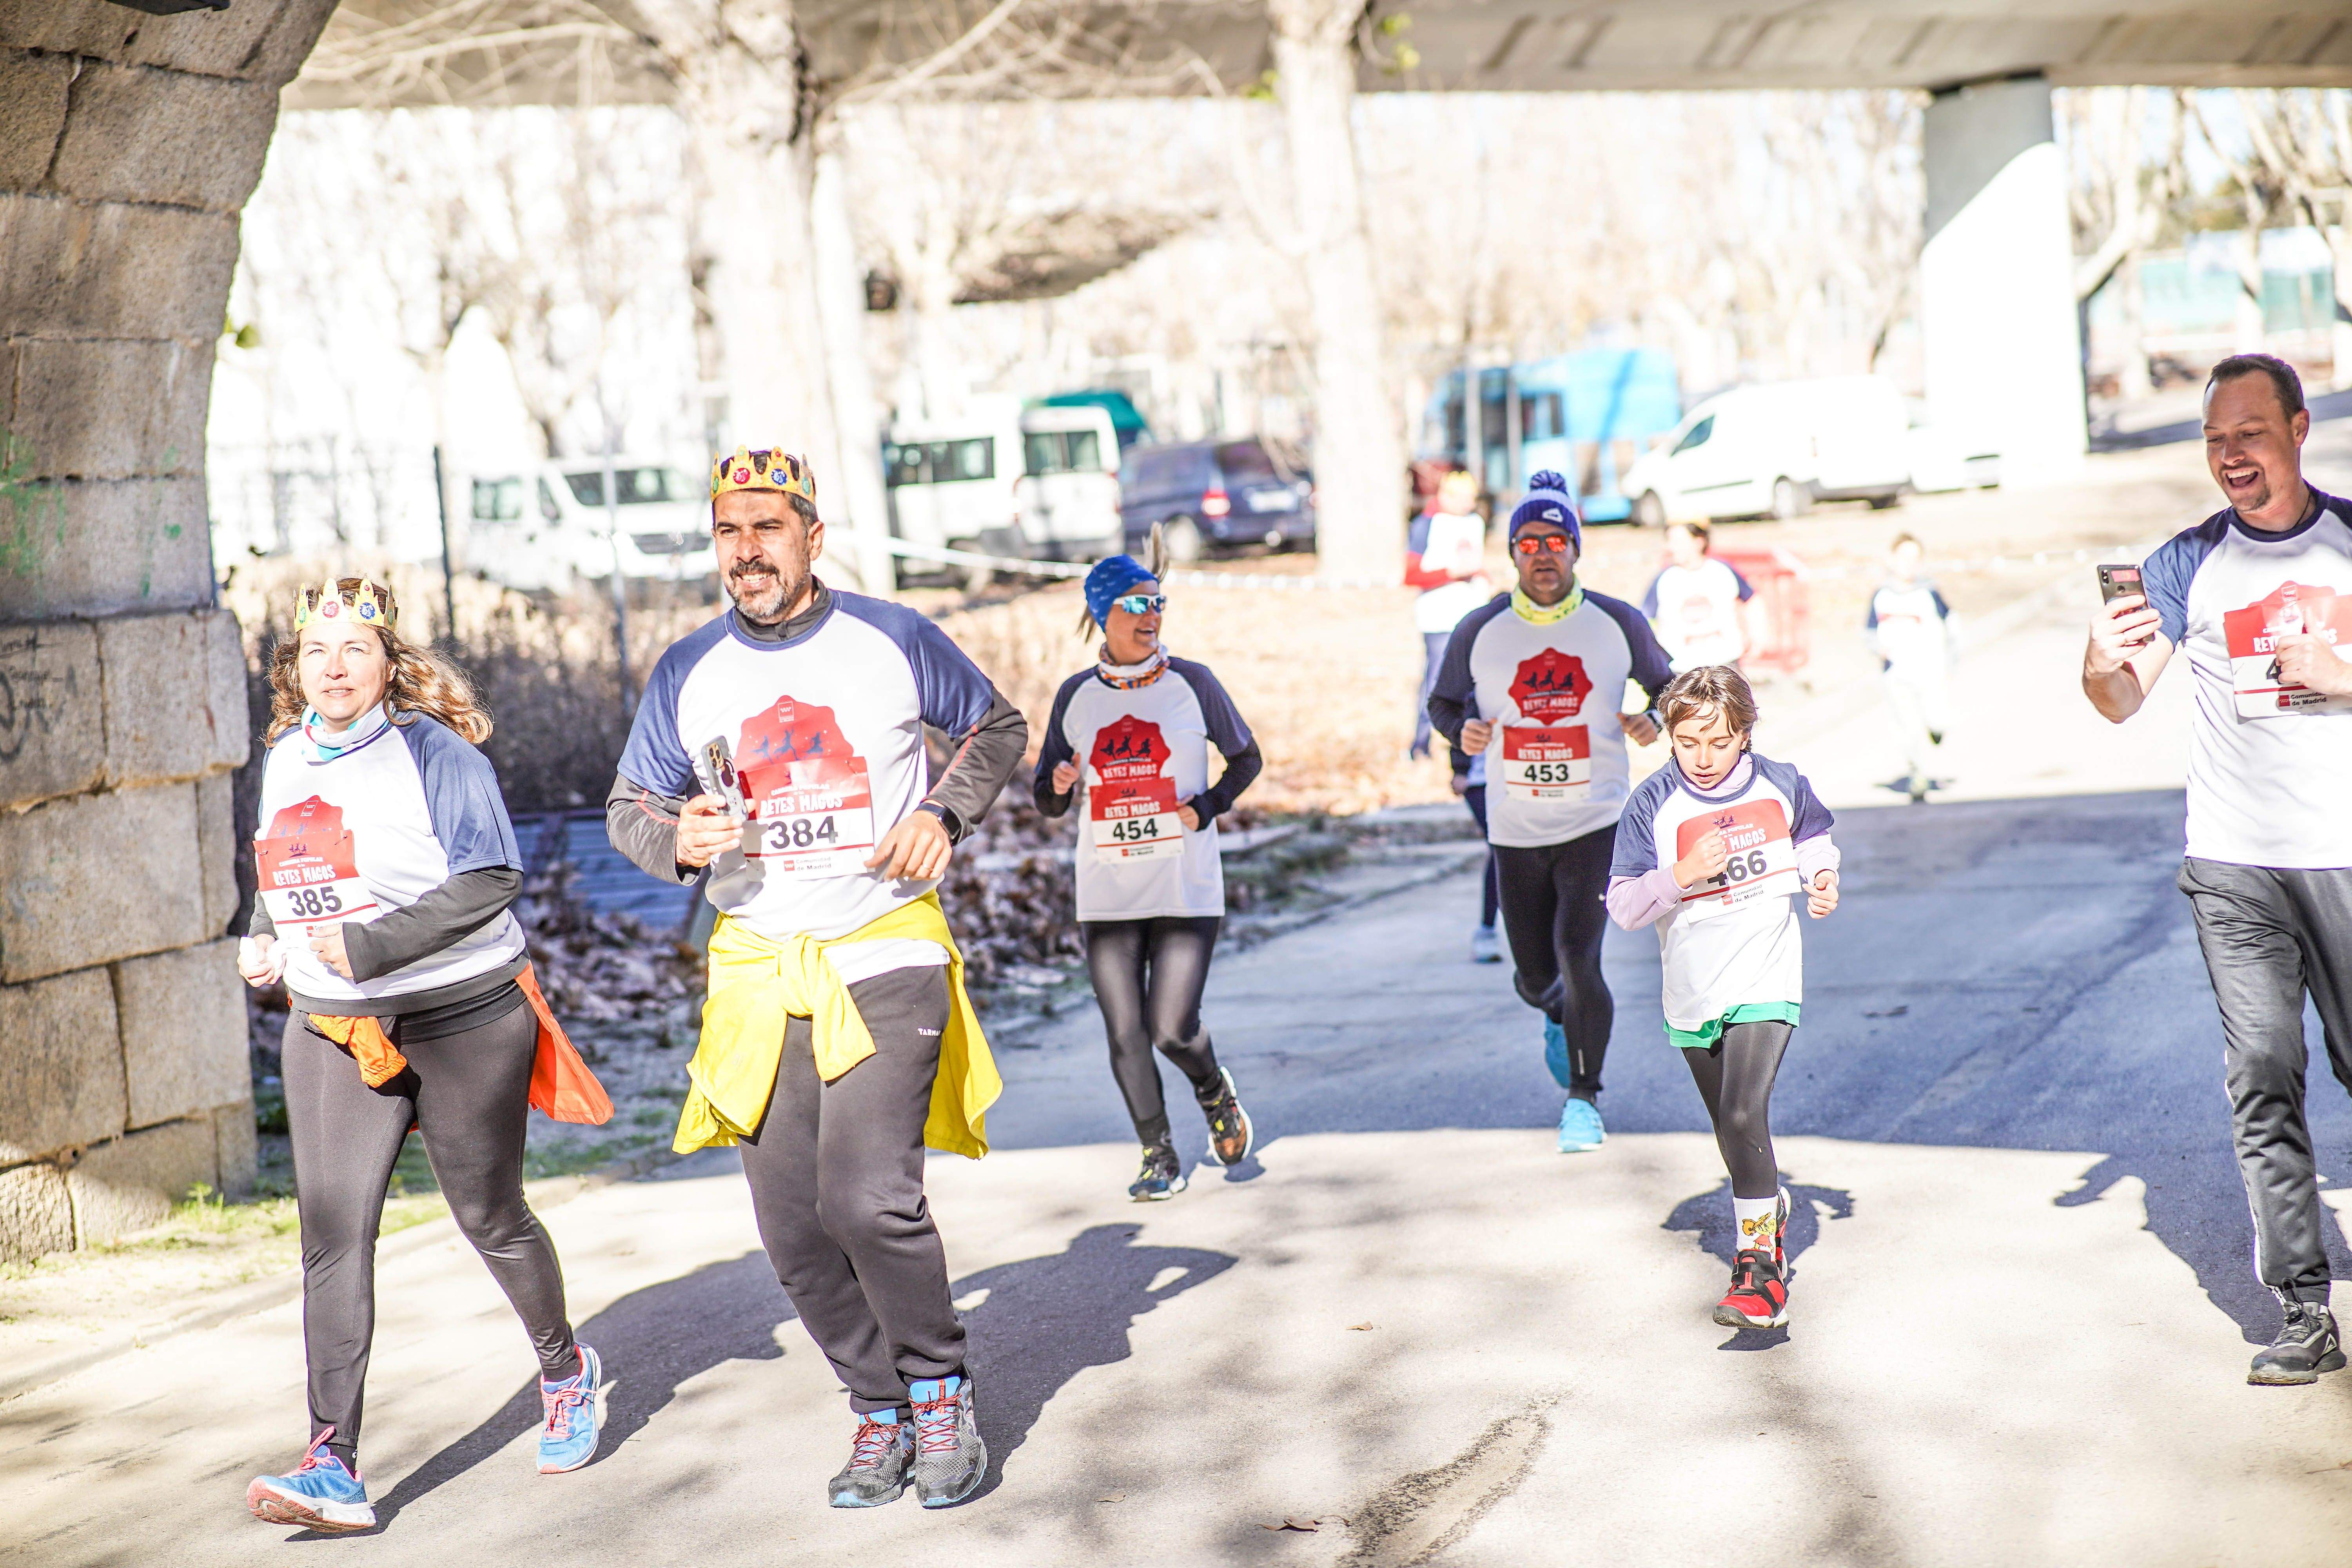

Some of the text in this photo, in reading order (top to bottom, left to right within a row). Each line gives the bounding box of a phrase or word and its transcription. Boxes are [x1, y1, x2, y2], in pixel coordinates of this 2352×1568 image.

[2253, 635, 2280, 653] REY
[1524, 763, 1568, 782] 453
[760, 797, 795, 817] REYES
[1105, 801, 1160, 818] REYES MAGOS
[768, 816, 838, 849] 384
[1113, 818, 1158, 840] 454
[1729, 828, 1767, 851] MAGOS
[273, 864, 336, 886] REYES MAGOS
[1733, 884, 1762, 897] Comunidad
[1744, 890, 1764, 900] Madrid
[288, 886, 342, 916] 385
